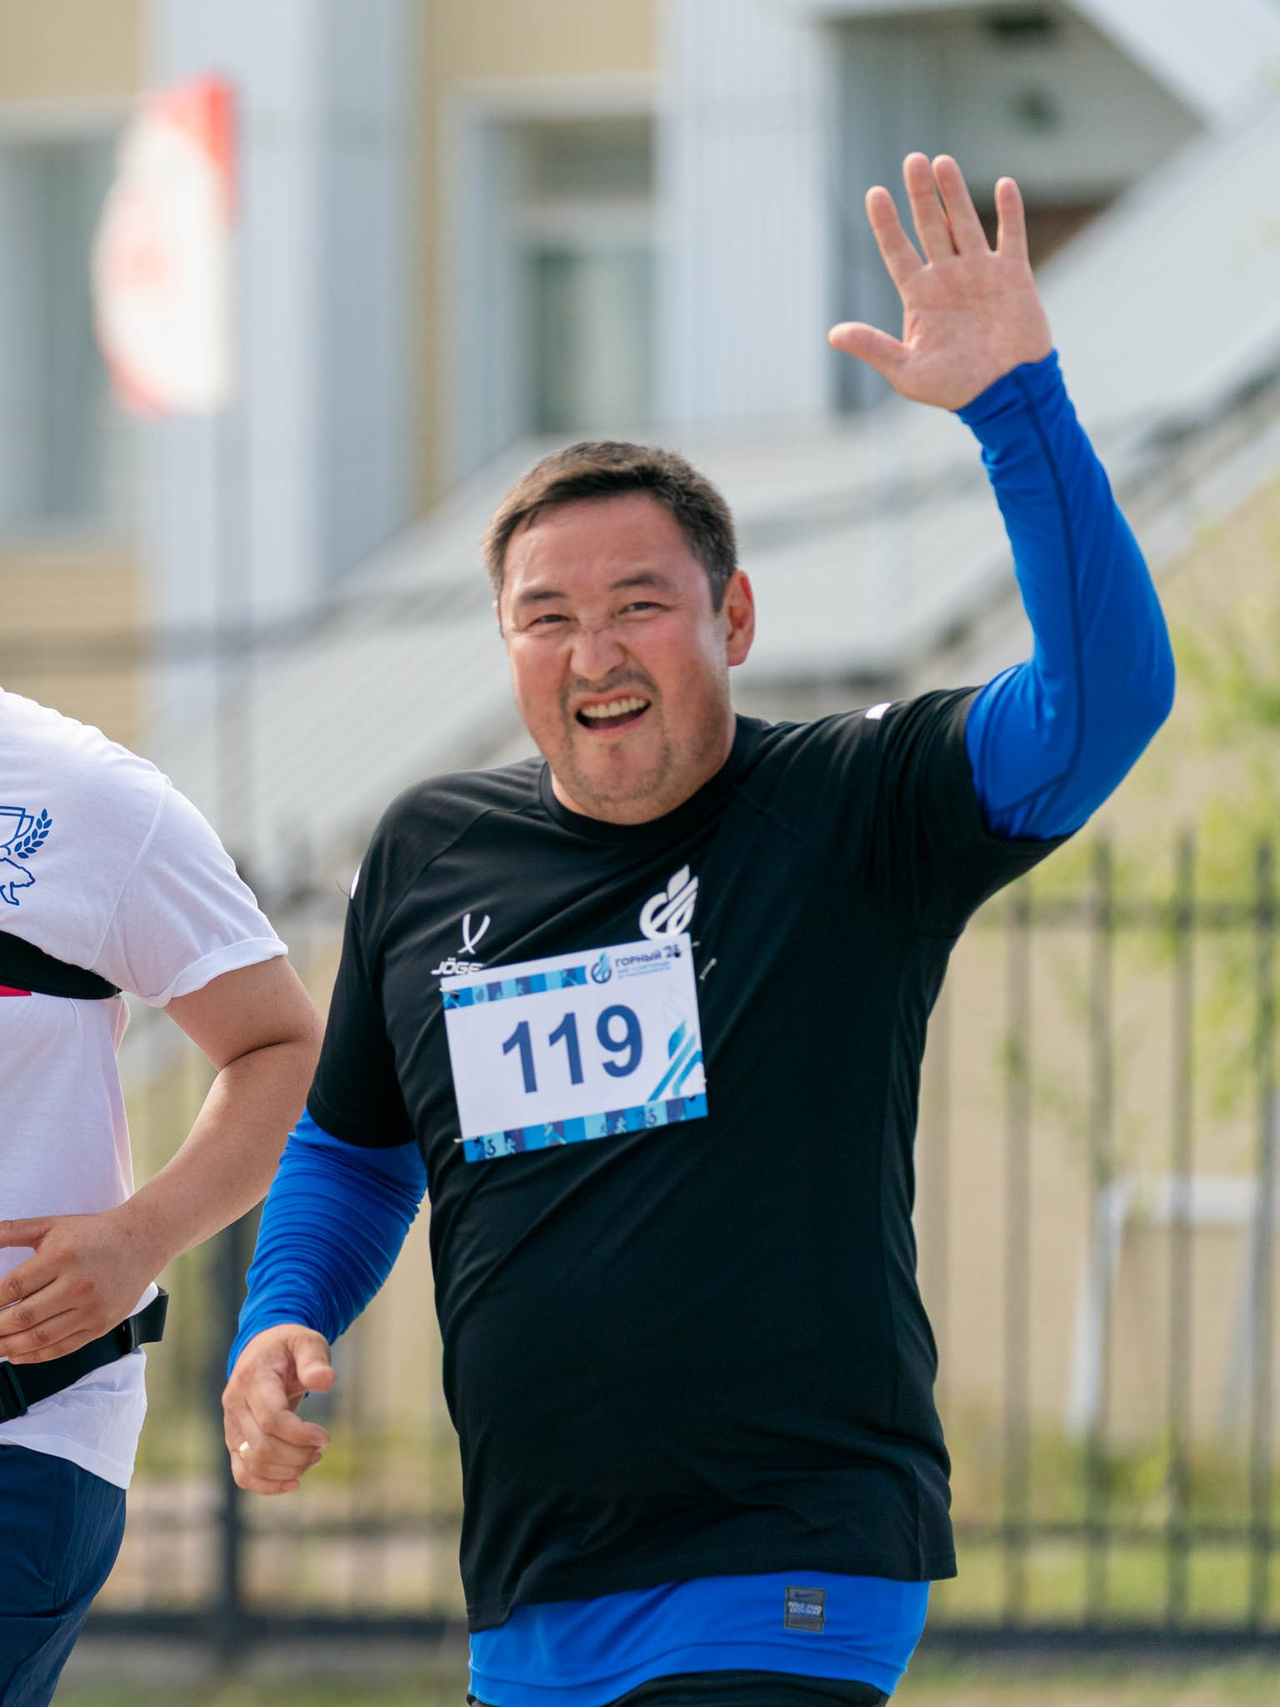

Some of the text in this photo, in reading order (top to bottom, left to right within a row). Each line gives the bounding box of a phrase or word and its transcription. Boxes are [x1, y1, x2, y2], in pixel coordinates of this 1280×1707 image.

[430, 957, 486, 975] JÖGE
[615, 949, 662, 967] ГОРНЫЙ
[501, 1004, 643, 1094] 119
